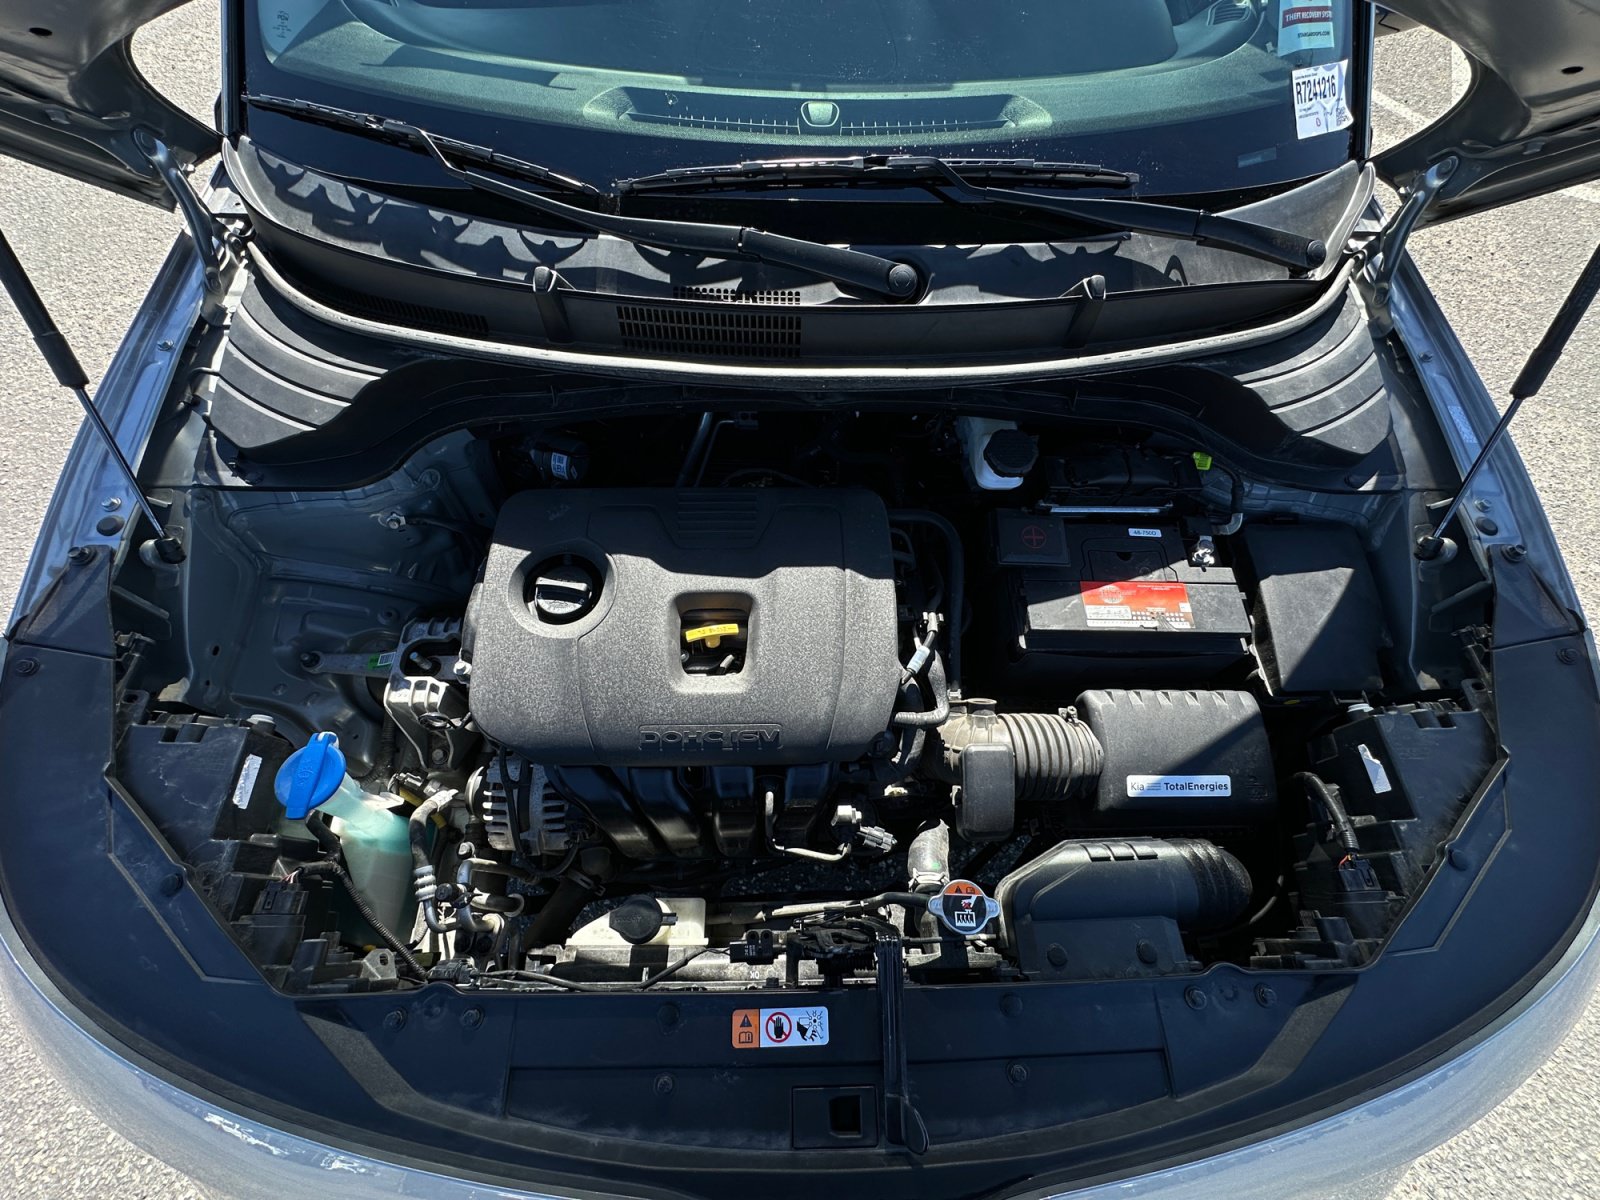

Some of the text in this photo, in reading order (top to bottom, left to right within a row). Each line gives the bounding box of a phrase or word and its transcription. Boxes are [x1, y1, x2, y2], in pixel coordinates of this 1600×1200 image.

[1285, 11, 1301, 21] THEFT
[1295, 74, 1336, 105] R7241216
[640, 730, 723, 748] DOHC
[1130, 782, 1229, 792] Kia TotalEnergies
